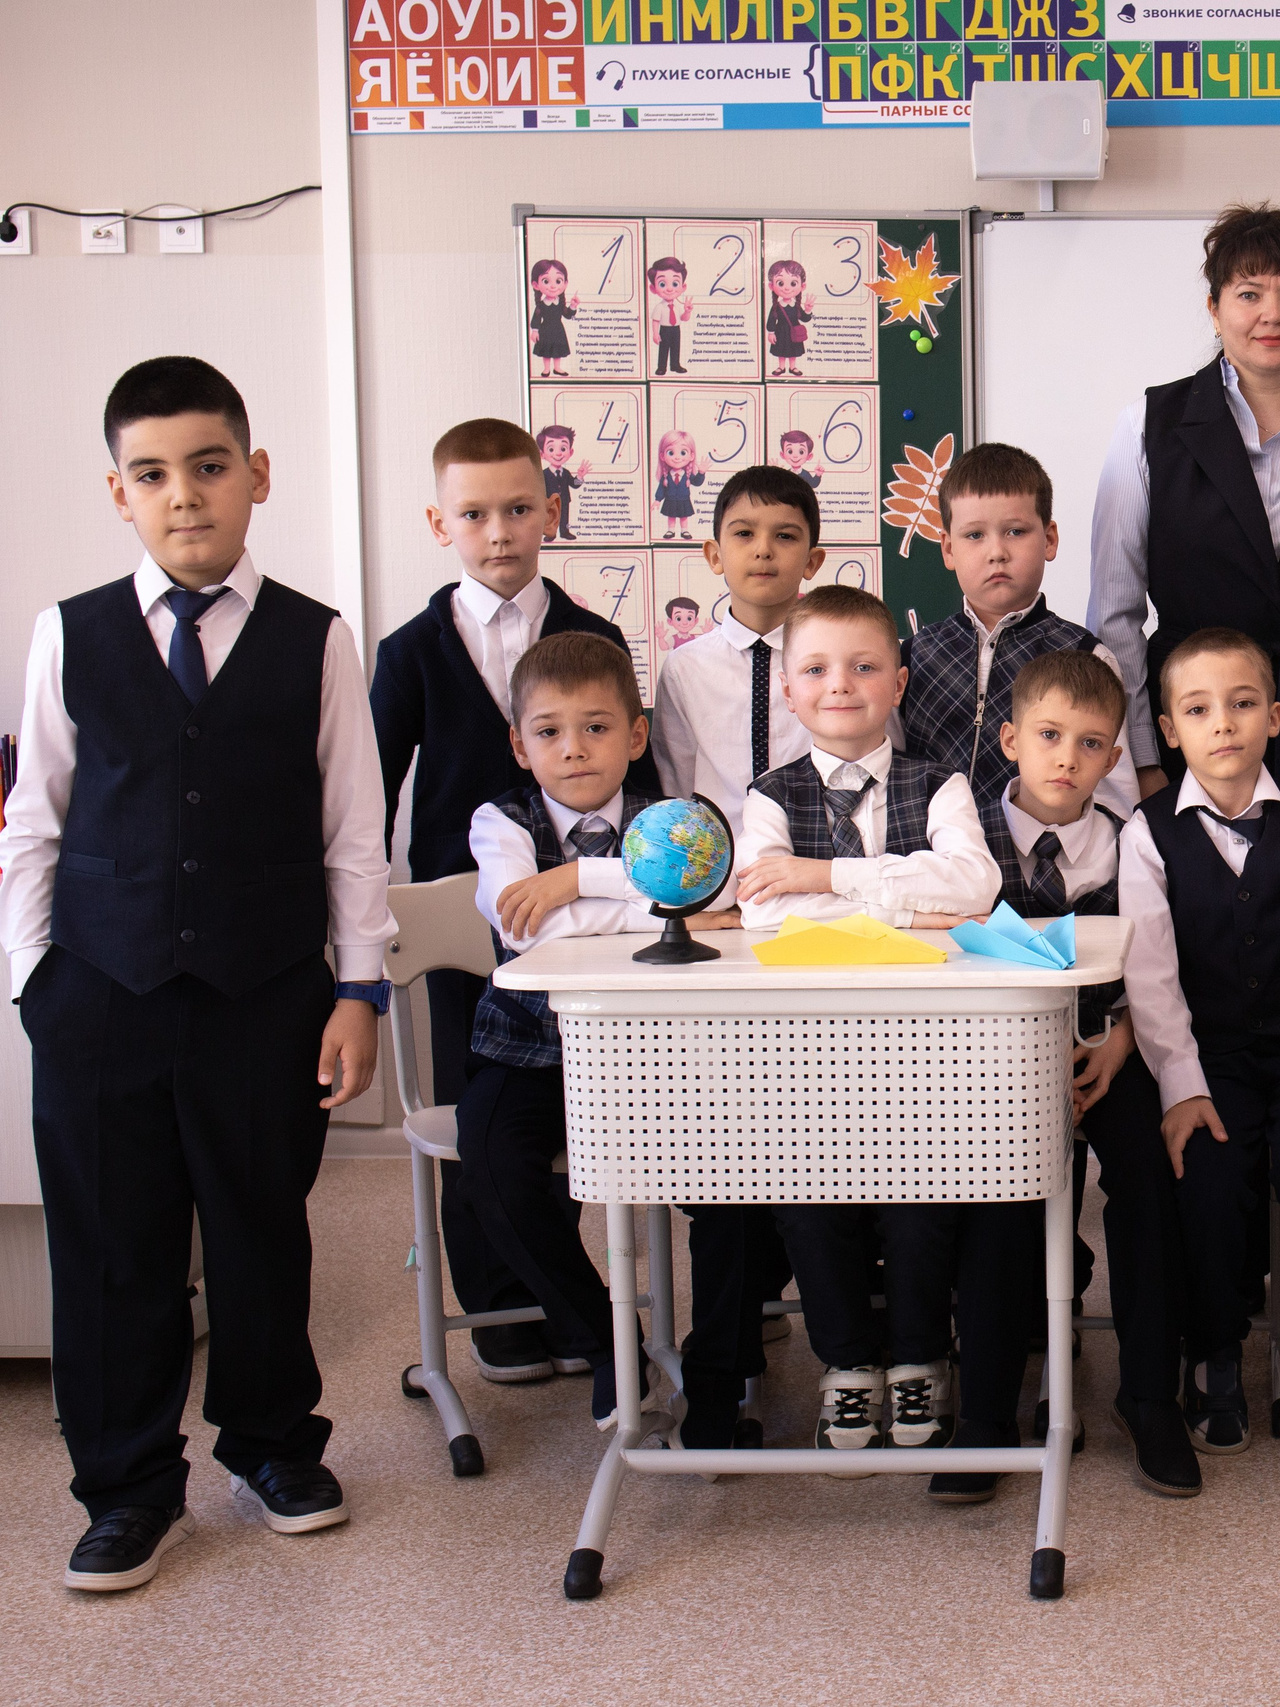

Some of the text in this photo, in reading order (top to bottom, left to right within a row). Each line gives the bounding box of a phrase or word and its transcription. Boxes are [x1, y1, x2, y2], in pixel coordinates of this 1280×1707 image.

[1142, 8, 1203, 19] ЗВОНКИЕ
[632, 68, 791, 81] ГЛУХИЕ СОГЛАСНЫЕ
[880, 105, 948, 117] ПАРНЫЕ
[598, 234, 861, 296] 1 2 3
[597, 400, 862, 464] 4 5 6
[599, 565, 635, 623] 7
